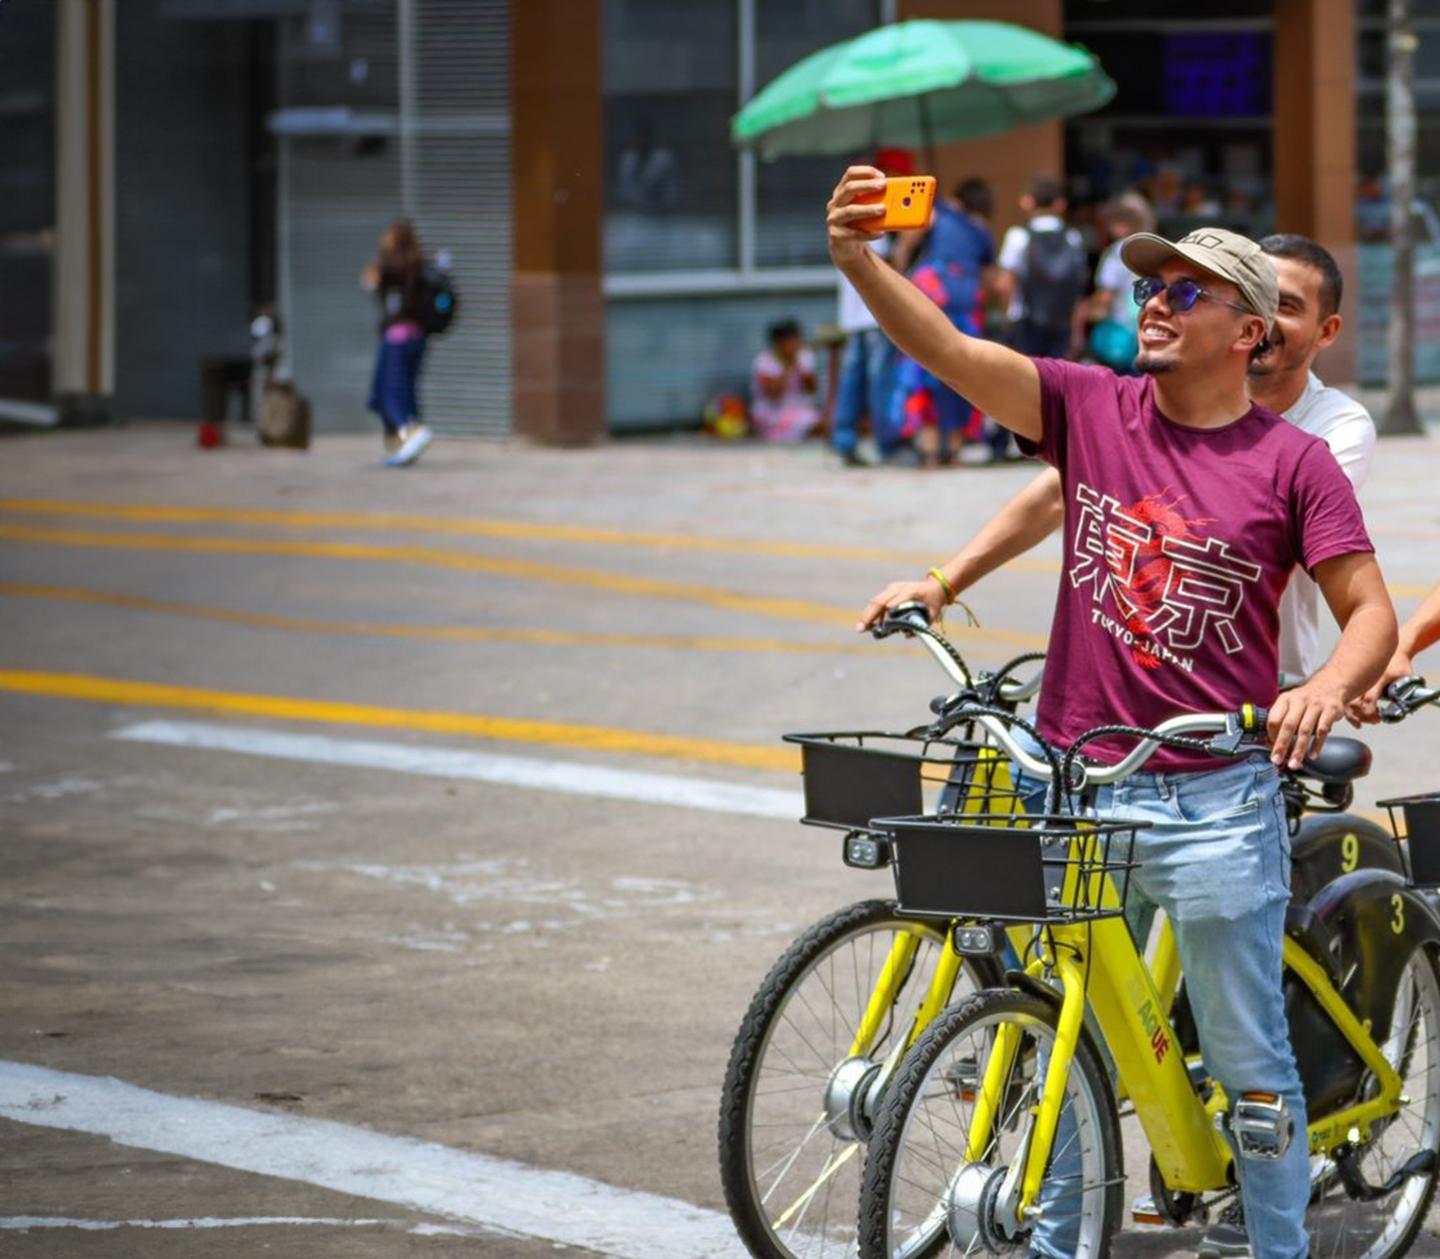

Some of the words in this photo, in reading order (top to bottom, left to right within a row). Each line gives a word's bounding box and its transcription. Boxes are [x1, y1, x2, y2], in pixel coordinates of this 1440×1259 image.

[1069, 483, 1262, 655] 東京
[1341, 832, 1359, 874] 9
[1390, 892, 1405, 935] 3
